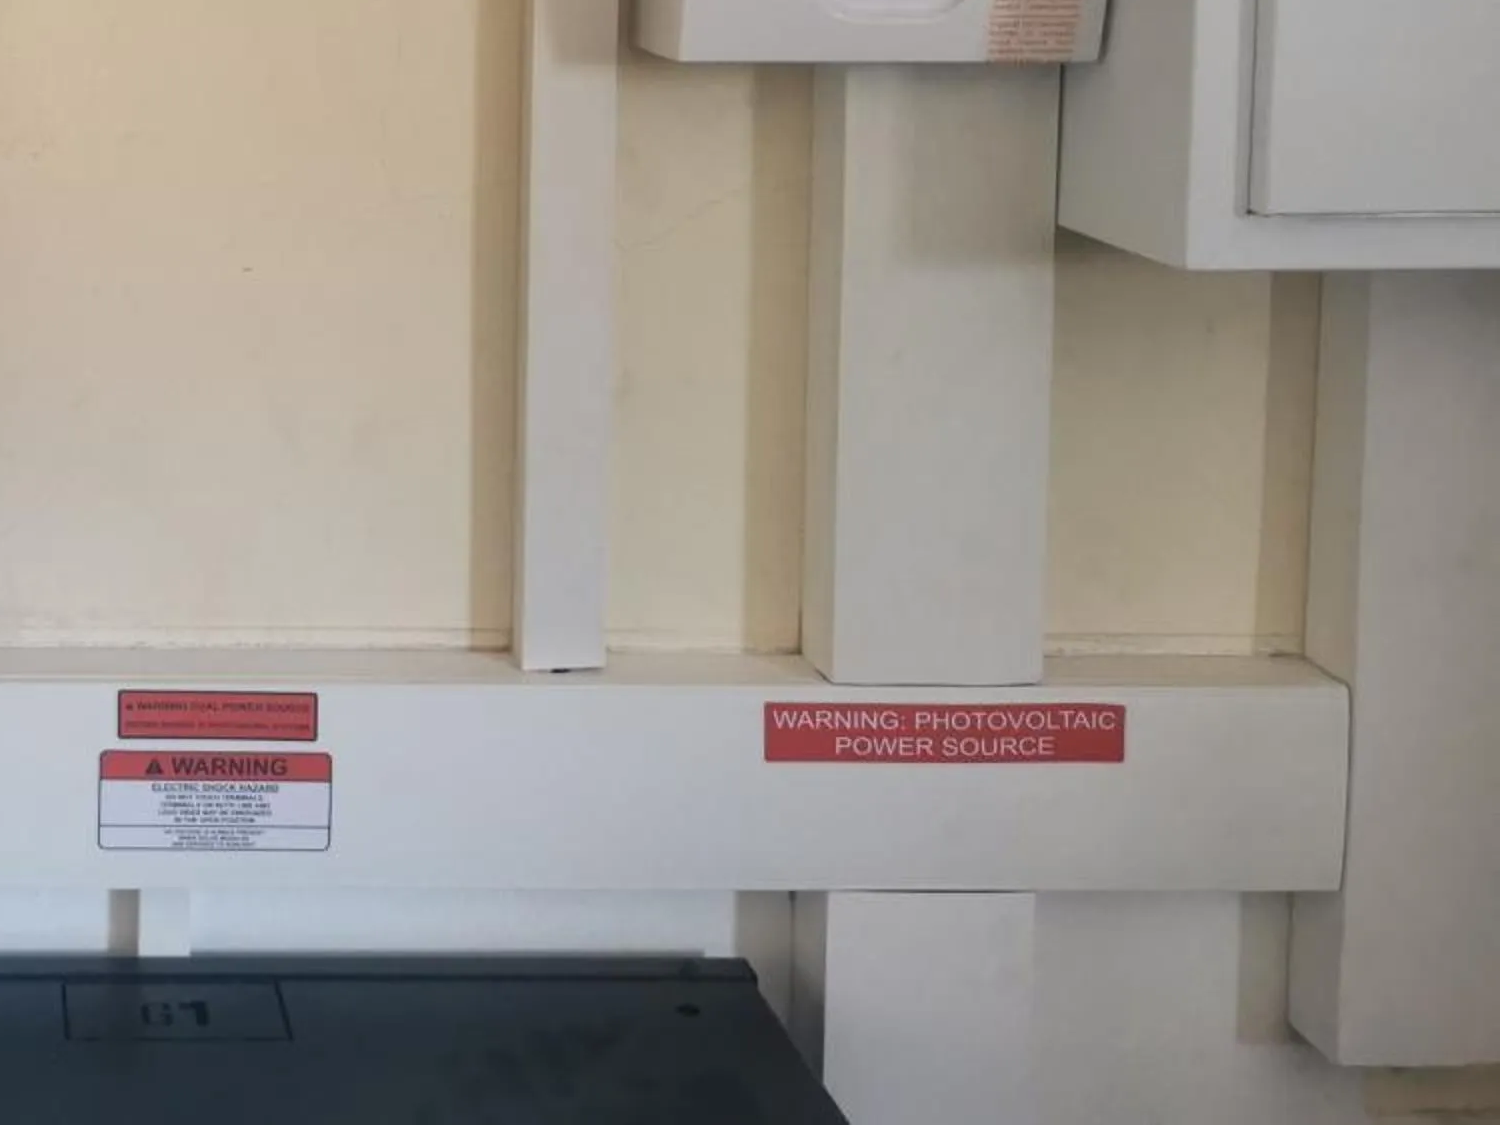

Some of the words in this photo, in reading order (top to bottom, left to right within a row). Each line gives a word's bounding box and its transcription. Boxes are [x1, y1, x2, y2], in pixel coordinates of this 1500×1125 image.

[773, 710, 906, 730] WARNING:
[915, 710, 1116, 731] PHOTOVOLTAIC
[835, 736, 934, 756] POWER
[941, 736, 1056, 756] SOURCE
[172, 758, 288, 776] WARNING
